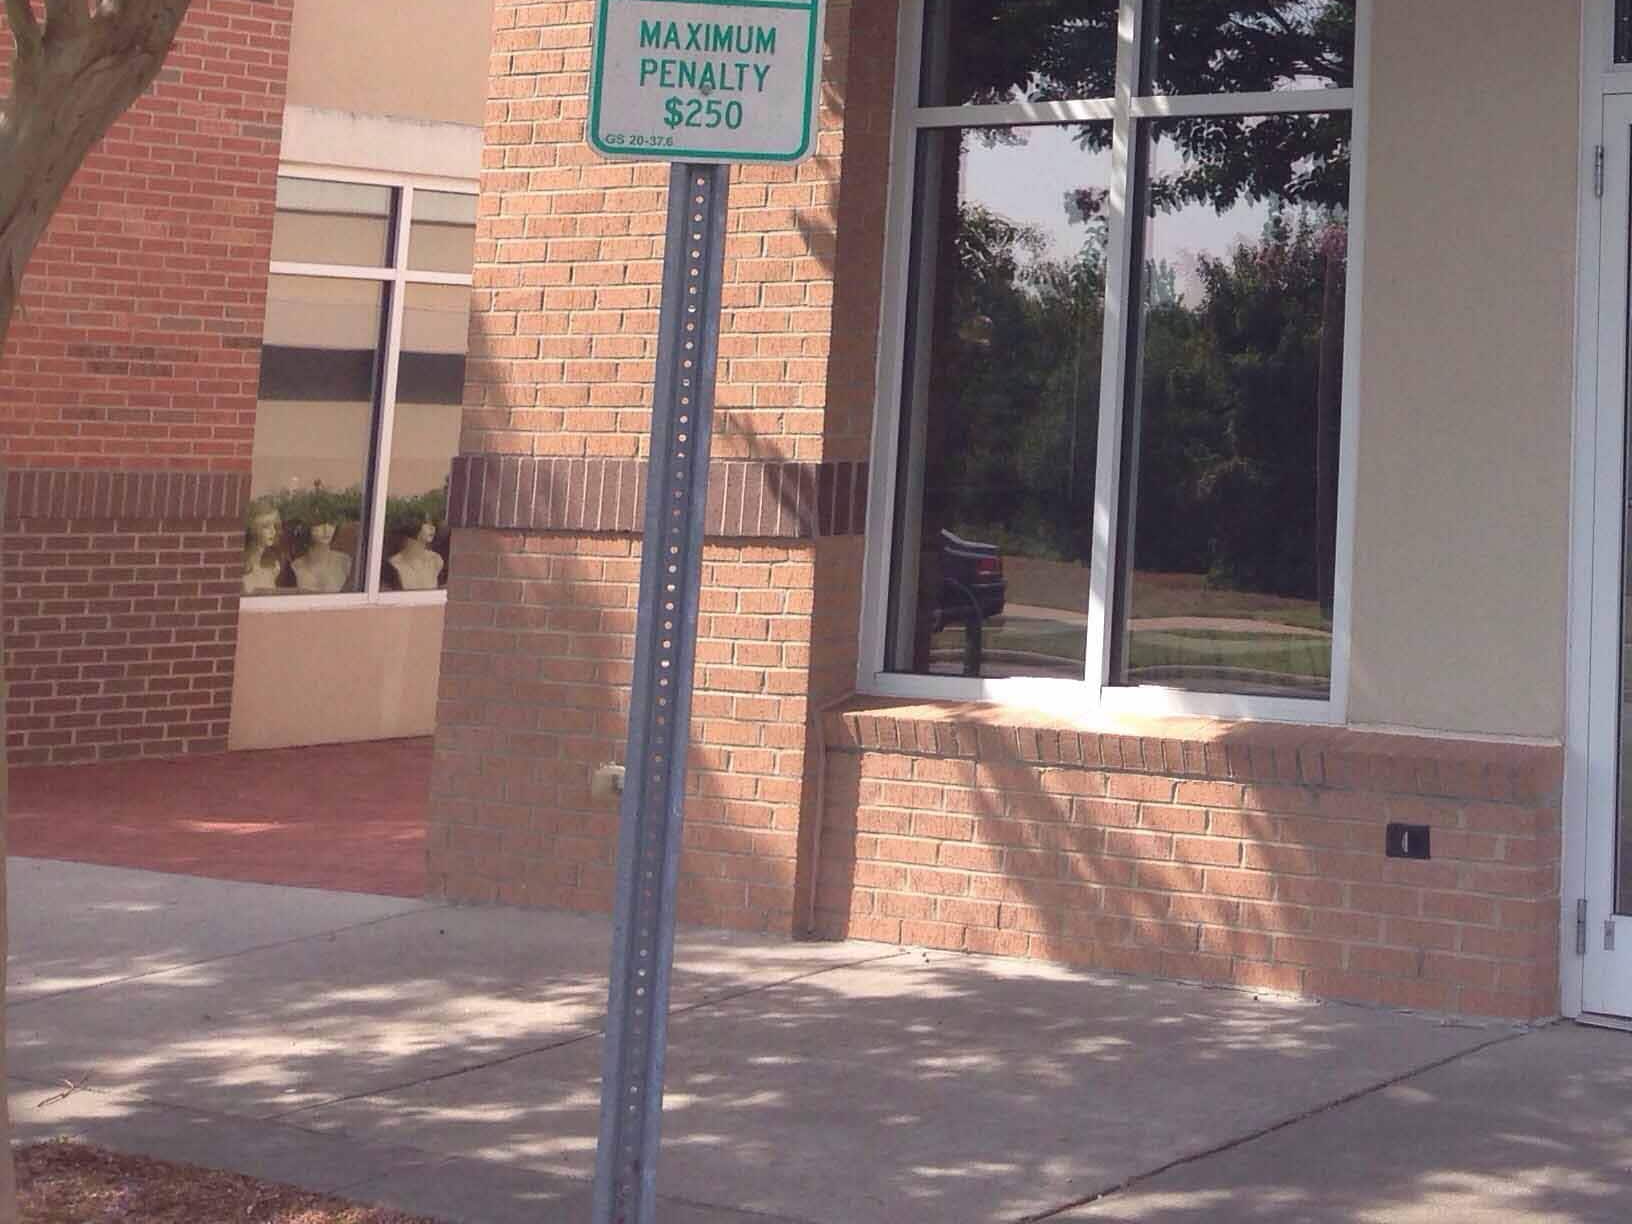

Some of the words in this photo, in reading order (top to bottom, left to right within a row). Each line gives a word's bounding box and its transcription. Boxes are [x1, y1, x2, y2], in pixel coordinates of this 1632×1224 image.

[639, 19, 778, 56] MAXIMUM
[639, 58, 771, 93] PENALTY
[663, 95, 743, 130] $250
[605, 134, 625, 145] GS
